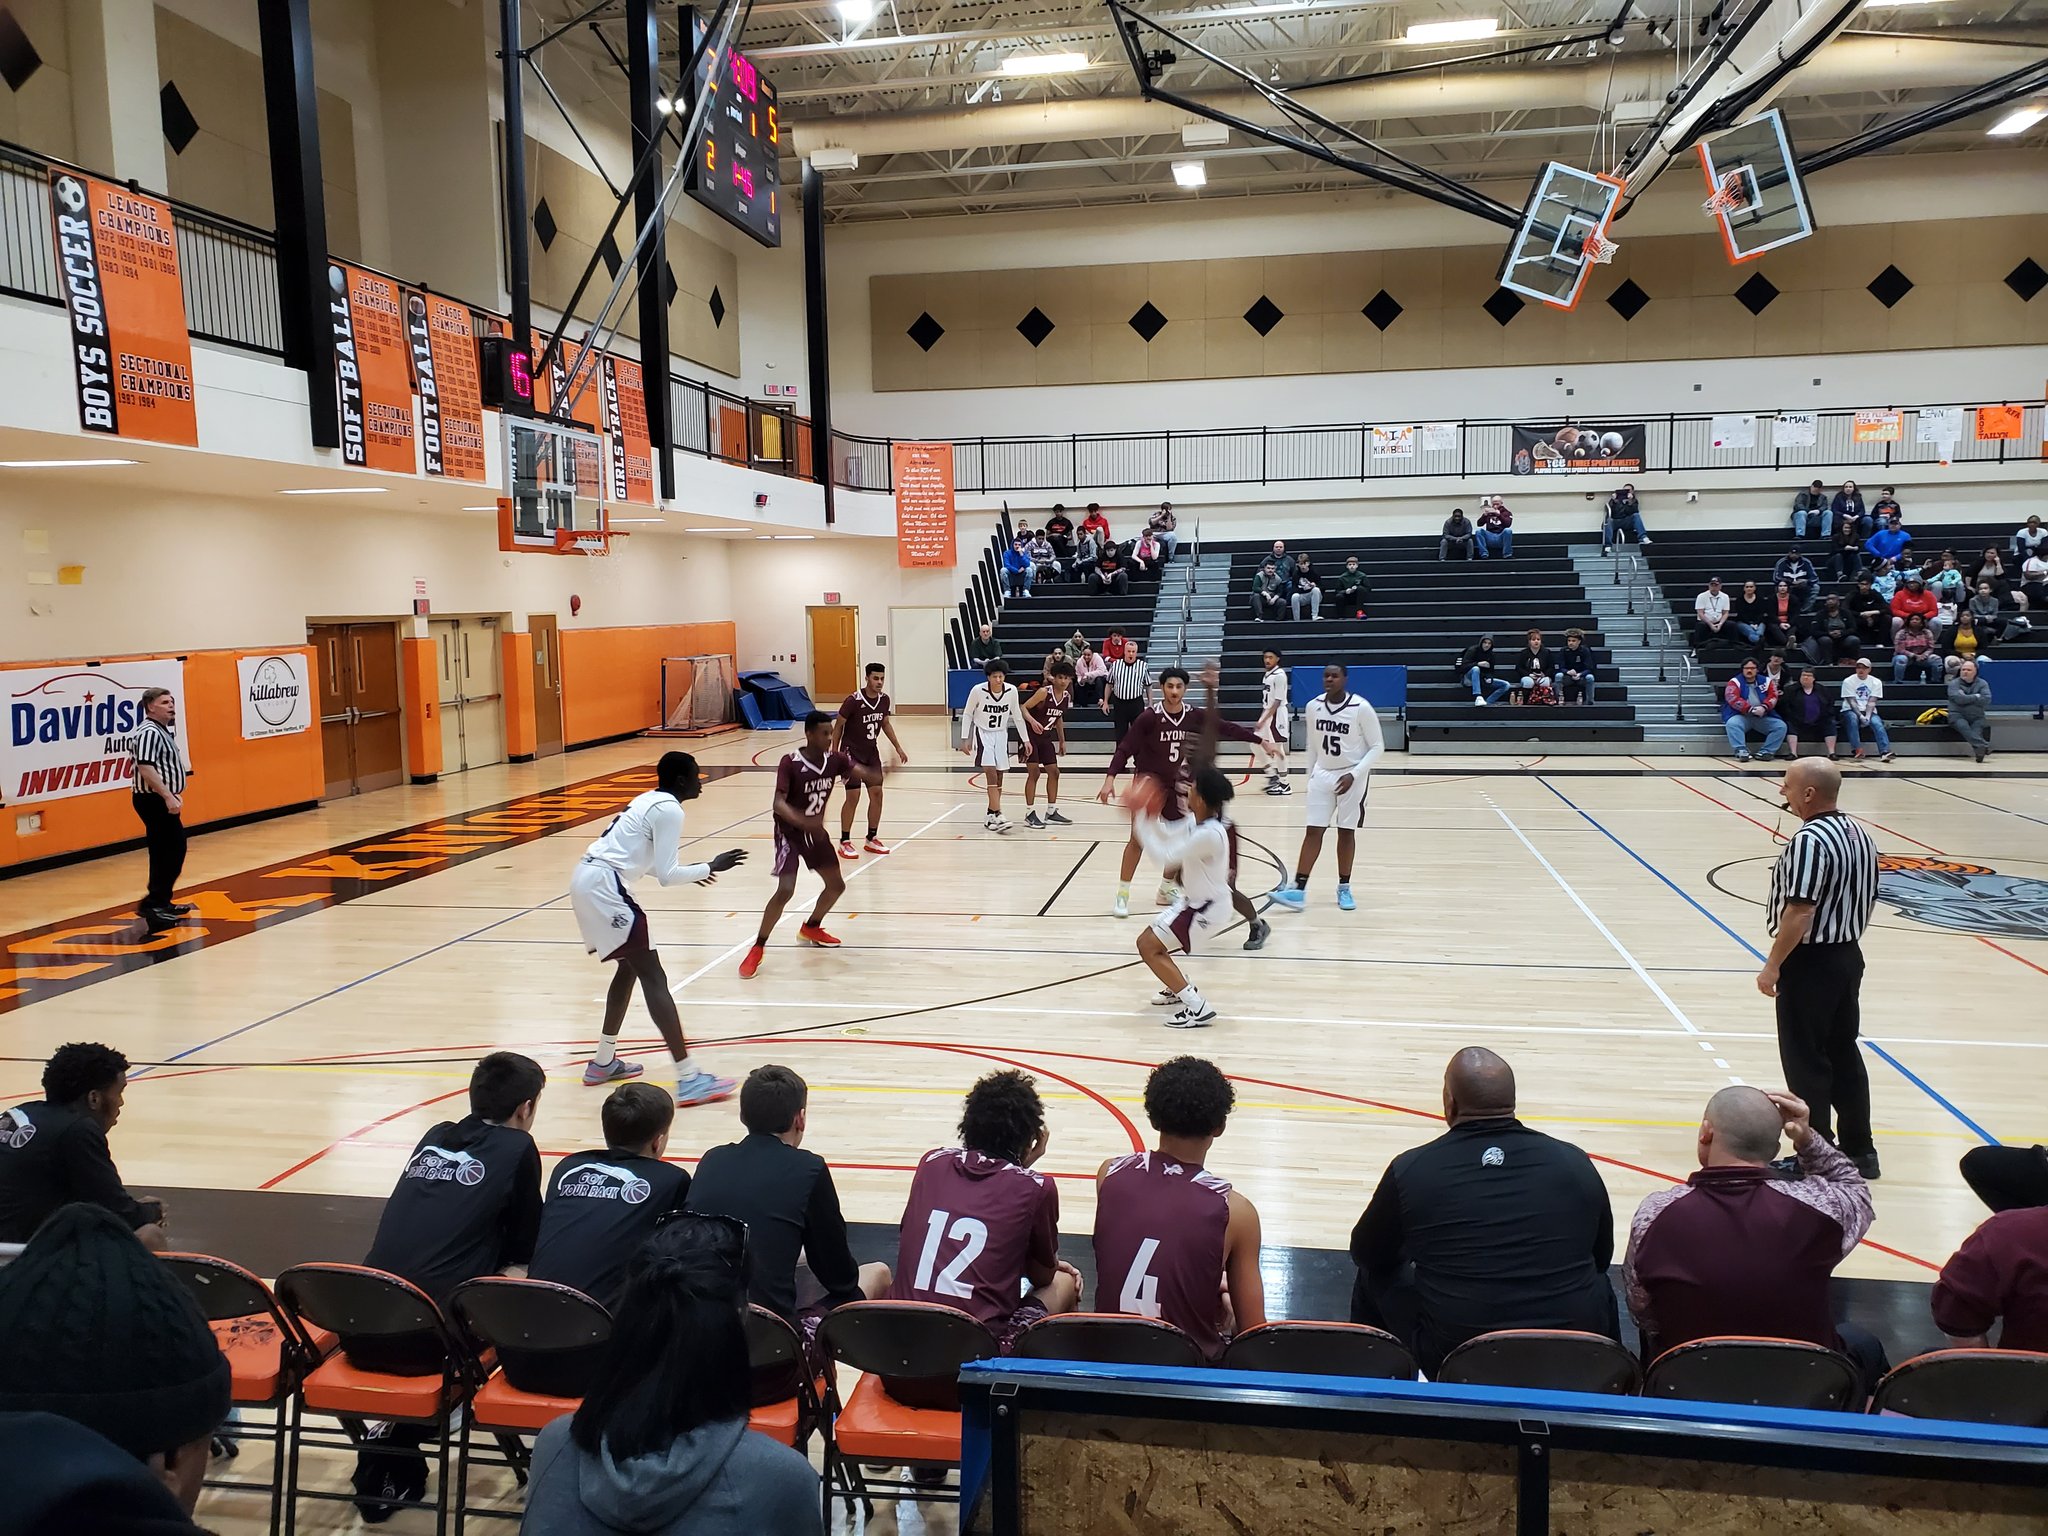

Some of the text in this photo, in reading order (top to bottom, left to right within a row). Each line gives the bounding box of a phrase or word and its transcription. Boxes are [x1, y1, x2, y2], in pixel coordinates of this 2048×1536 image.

[107, 192, 157, 223] LEAGUE
[97, 208, 171, 247] CHAMPIONS
[358, 274, 390, 298] LEAGUE
[352, 289, 398, 316] CHAMPIONS
[435, 302, 462, 321] LEAGUE
[58, 214, 112, 428] BOYS SOCCER
[431, 315, 470, 337] CHAMPIONS
[119, 352, 189, 381] SECTIONAL
[511, 352, 530, 397] 6
[120, 373, 191, 402] CHAMPIONS
[330, 297, 363, 462] SOFTBALL
[410, 319, 441, 472] FOOTBALL
[367, 401, 411, 423] SECTIONAL
[2005, 407, 2021, 419] RFA
[368, 418, 413, 439] CHAMPIONS
[444, 416, 481, 435] SECTIONAL
[1978, 432, 2008, 440] TAILYN
[445, 432, 482, 450] CHAMPIONS
[606, 376, 626, 499] GIRLS TRACK
[249, 683, 300, 702] killabrew
[982, 703, 1009, 713] ATOMS
[988, 715, 1002, 728] 21
[1160, 730, 1186, 742] LYON
[1168, 742, 1181, 763] 5
[804, 778, 833, 793] LYONS
[805, 792, 827, 817] 25
[420, 1154, 449, 1170] GOT
[579, 1172, 609, 1185] GOT
[560, 1183, 620, 1200] YOUR BACK
[913, 1209, 988, 1300] 12
[1119, 1237, 1162, 1318] 4
